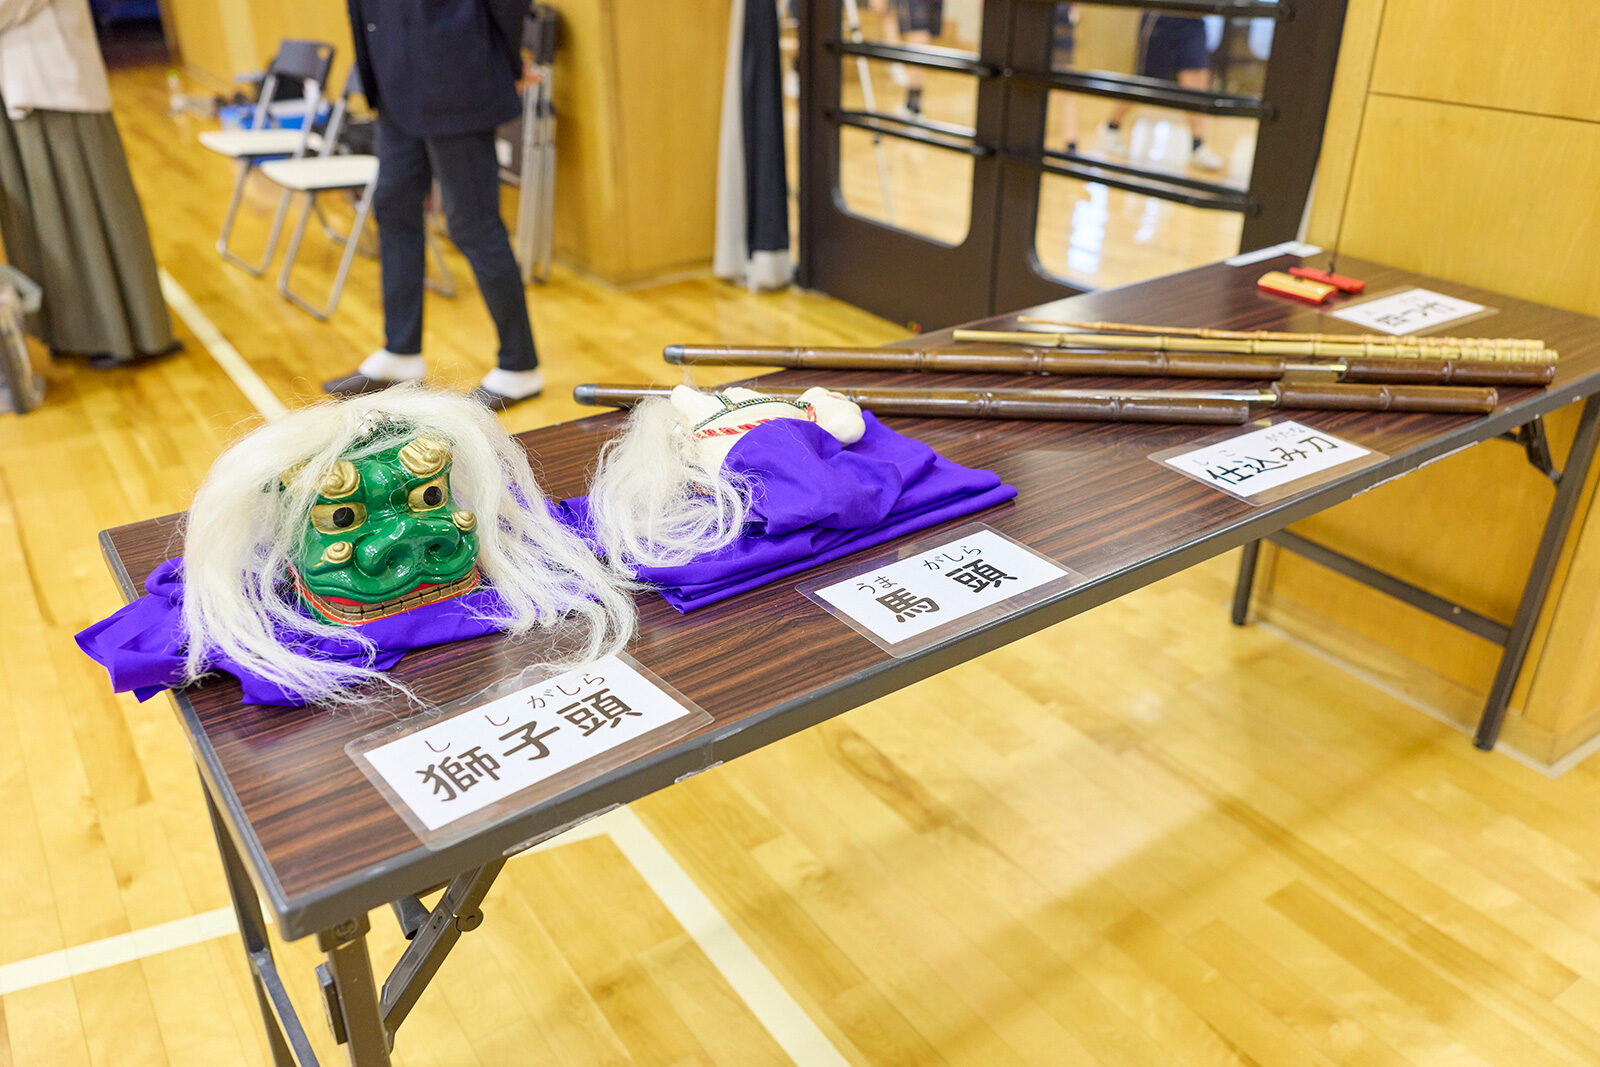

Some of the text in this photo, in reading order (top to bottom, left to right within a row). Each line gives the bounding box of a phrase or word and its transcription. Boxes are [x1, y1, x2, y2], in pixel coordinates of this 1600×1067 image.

[1206, 436, 1338, 485] 仕込み刀
[856, 545, 982, 595] うま がしら
[527, 673, 605, 709] がしら
[415, 688, 643, 802] 獅子頭
